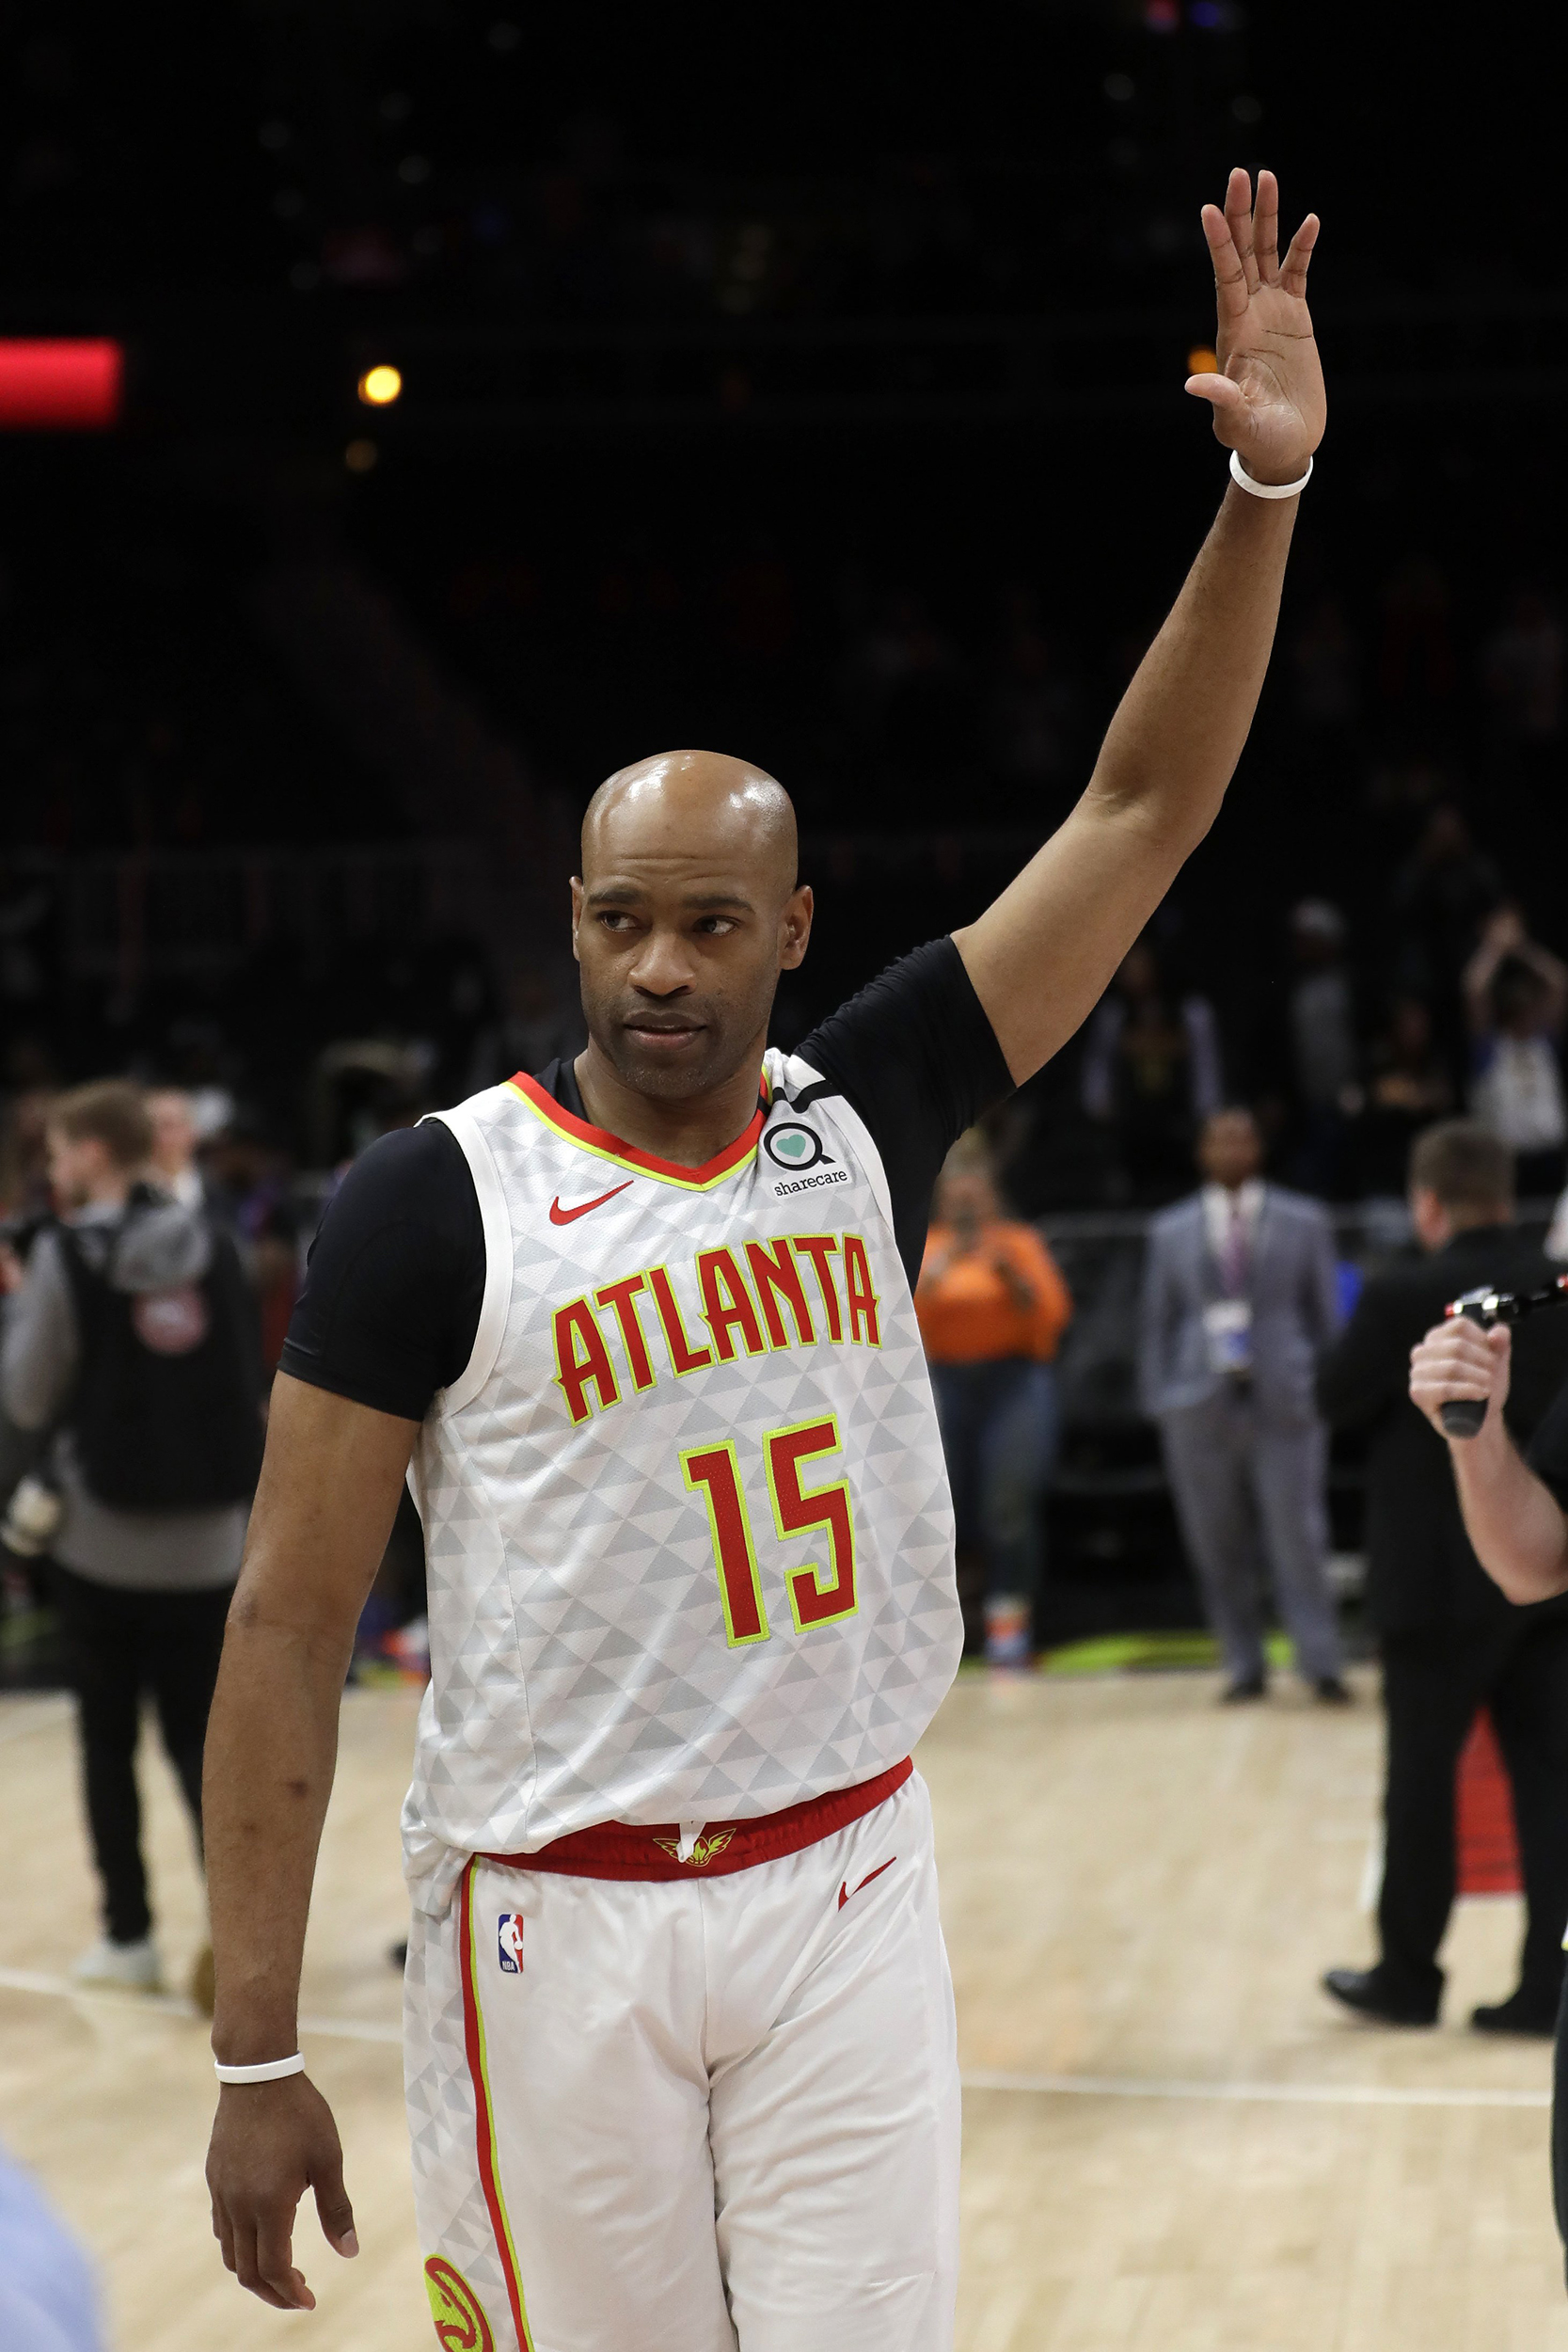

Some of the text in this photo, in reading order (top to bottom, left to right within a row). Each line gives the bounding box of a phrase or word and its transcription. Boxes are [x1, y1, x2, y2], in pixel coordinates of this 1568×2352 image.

[774, 1170, 847, 1196] sharecare
[552, 1233, 880, 1427] ATLANTA
[678, 1414, 858, 1648] 15
[502, 1961, 515, 1971] NBA
